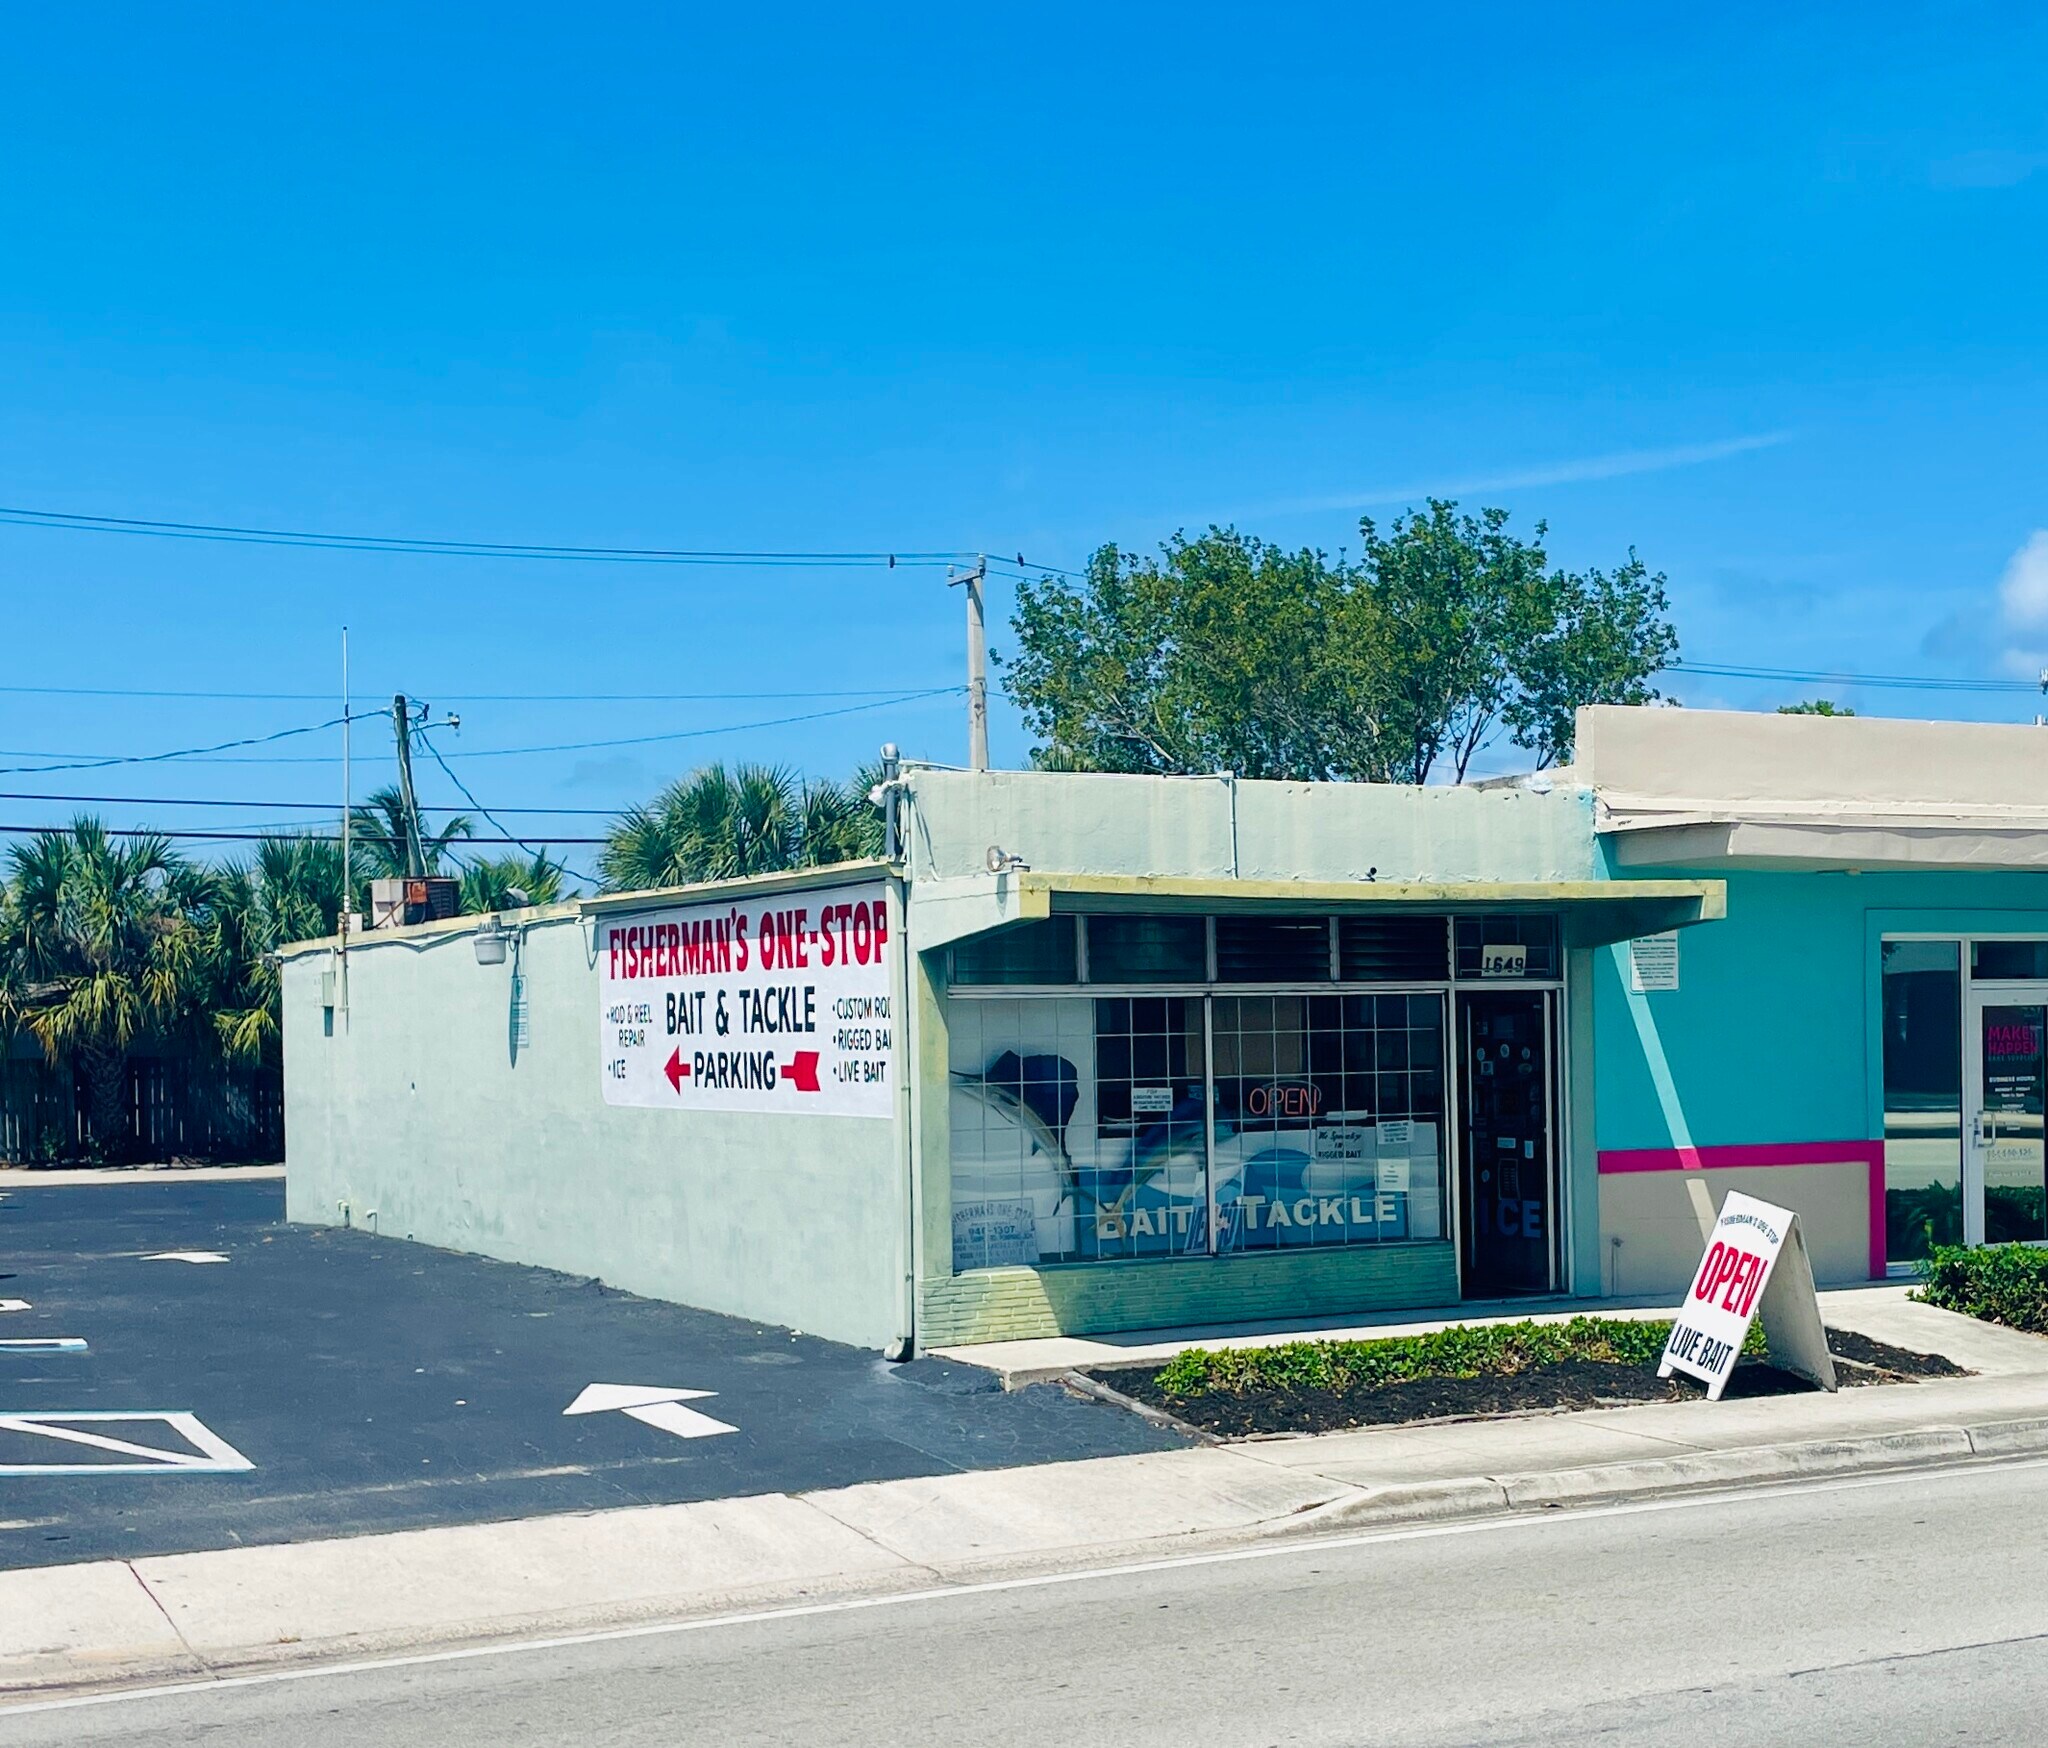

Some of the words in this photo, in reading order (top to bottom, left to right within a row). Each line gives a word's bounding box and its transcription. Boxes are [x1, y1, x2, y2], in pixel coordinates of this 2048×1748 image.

[609, 907, 749, 980] FISHERMAN'S
[759, 901, 888, 971] ONE-STOP
[1484, 956, 1524, 973] 1649
[610, 1005, 626, 1024] ROD
[634, 1004, 653, 1024] REEL
[666, 991, 706, 1035] BAIT
[715, 989, 730, 1037] &
[739, 986, 816, 1034] TACKLE
[837, 996, 873, 1020] CUSTOM
[618, 1029, 646, 1048] REPAIR
[838, 1028, 872, 1051] RIGGED
[875, 1028, 892, 1051] BAI
[612, 1059, 626, 1079] ICE
[694, 1050, 776, 1091] PARKING
[838, 1060, 860, 1083] LIVE
[863, 1060, 886, 1083] BAIT
[1249, 1087, 1318, 1115] OPEN
[1346, 1150, 1361, 1158] BAIT
[1096, 1203, 1194, 1240] BAIT
[1236, 1195, 1398, 1230] TACKLE
[1479, 1200, 1542, 1238] ICE
[1695, 1241, 1769, 1318] OPEN
[1668, 1324, 1703, 1362] LIVE
[1697, 1336, 1734, 1375] BAIT
